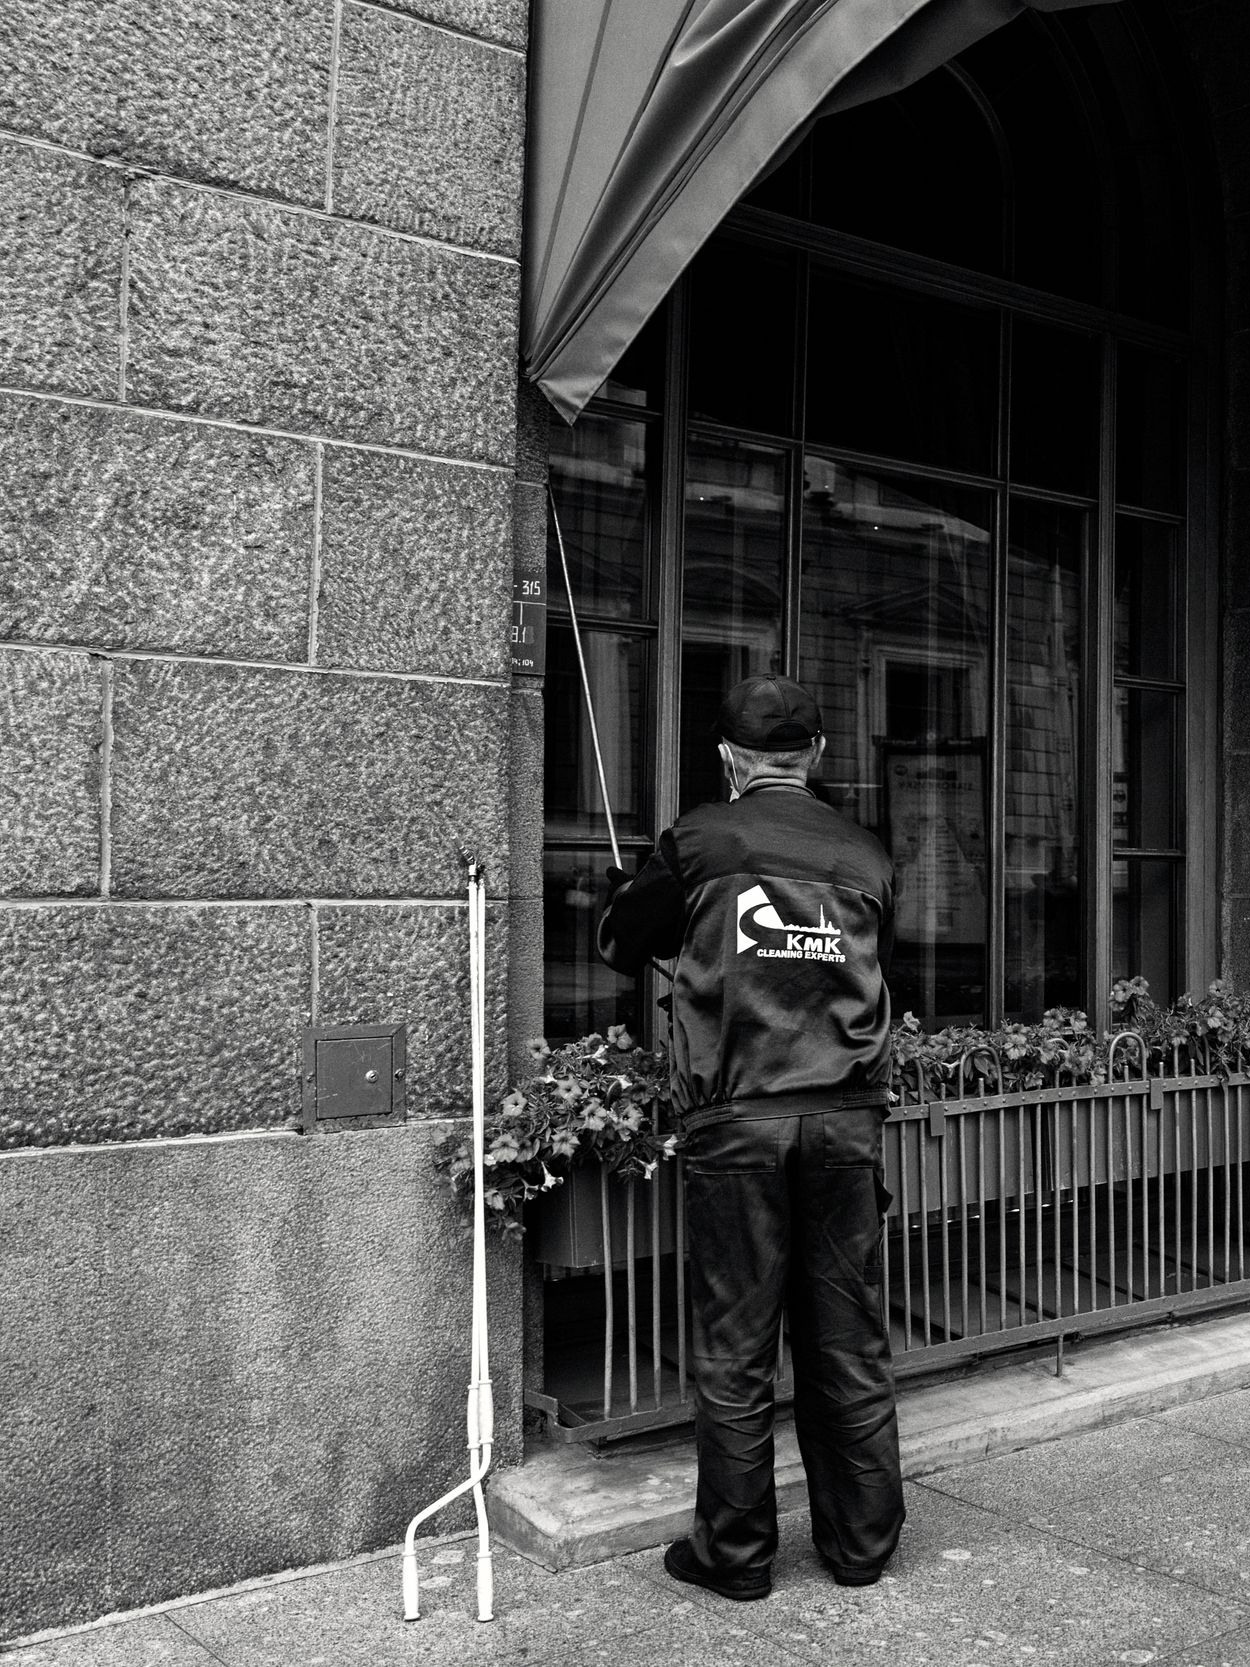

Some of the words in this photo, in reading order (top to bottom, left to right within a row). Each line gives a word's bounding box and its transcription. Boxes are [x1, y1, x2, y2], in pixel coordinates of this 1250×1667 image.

[522, 580, 541, 595] 315
[757, 948, 803, 959] CLEANING
[804, 951, 846, 963] EXPERTS
